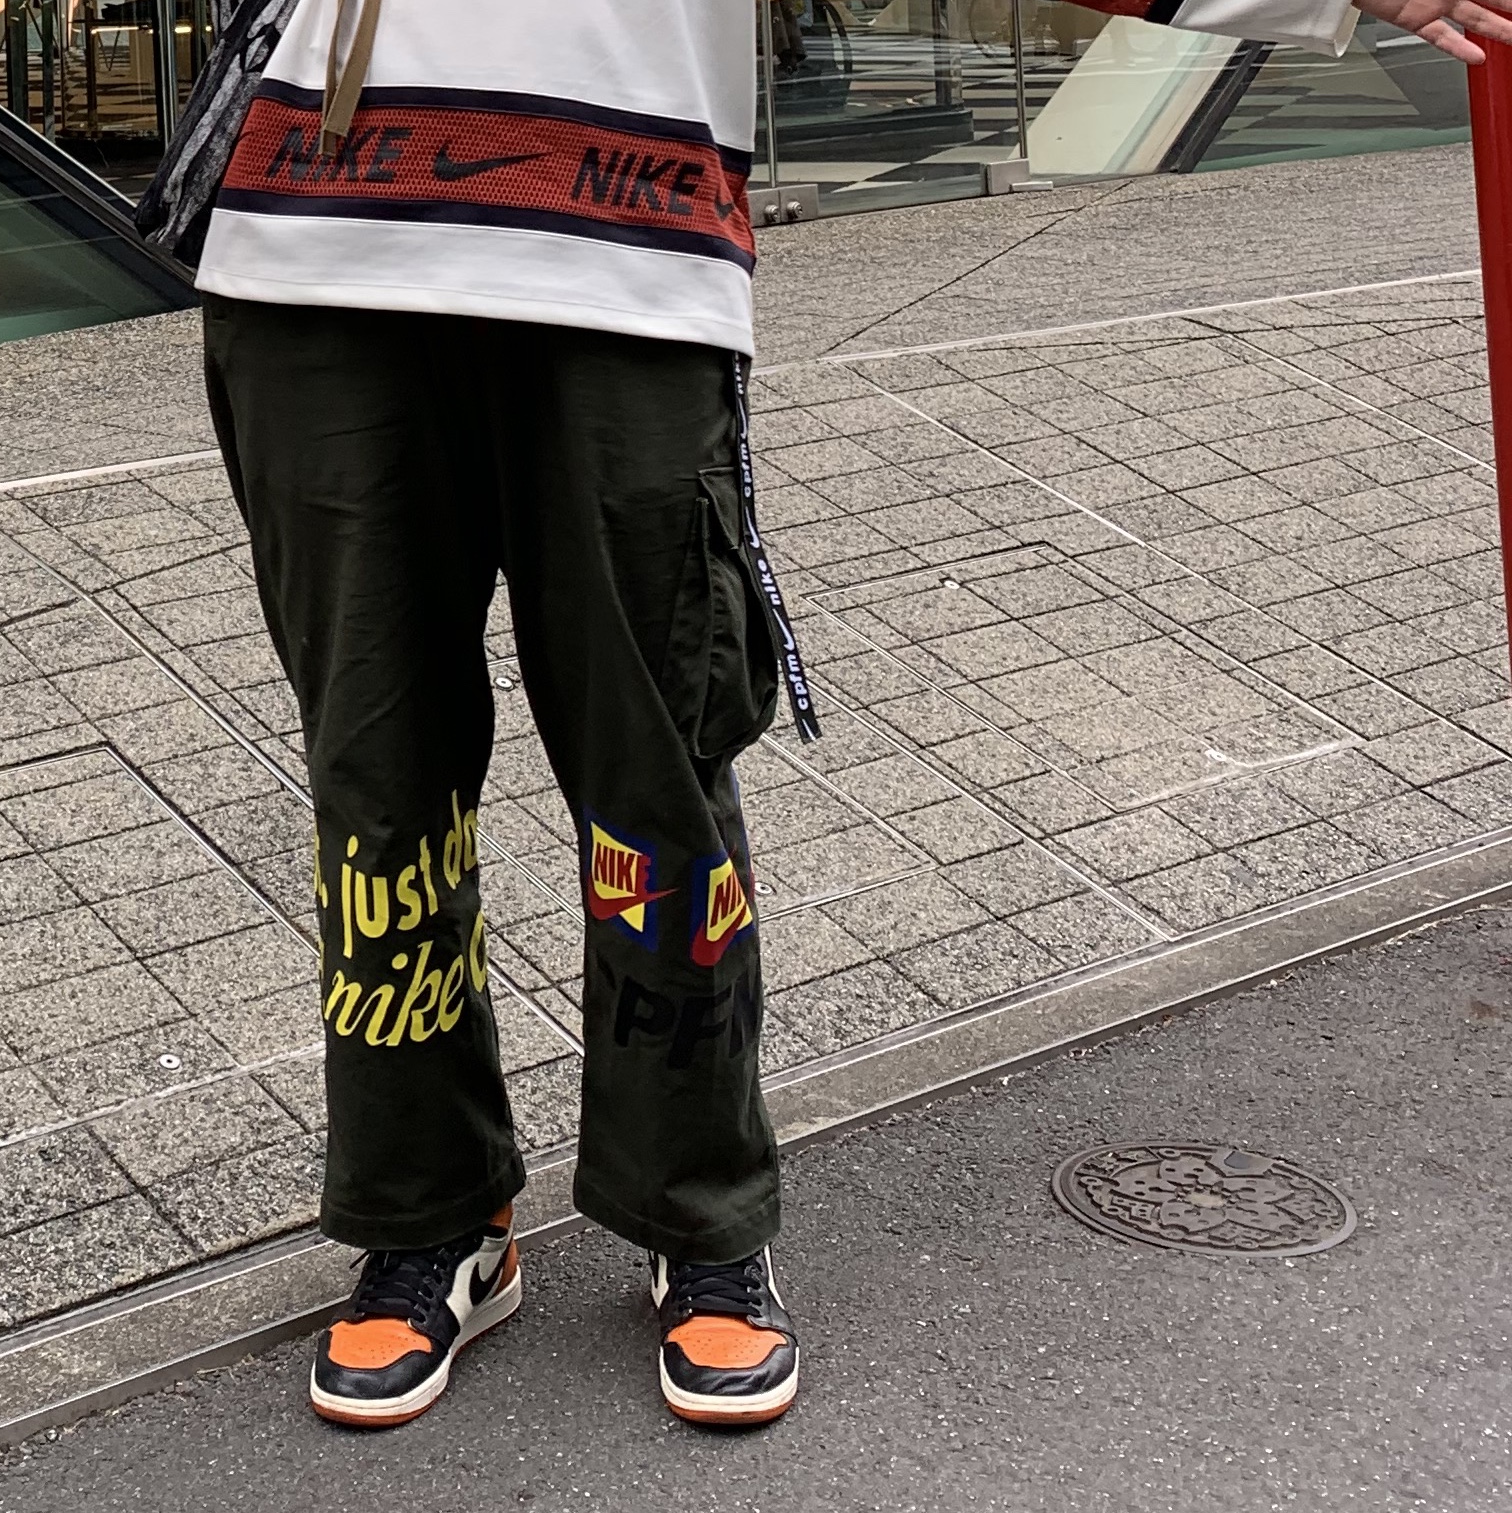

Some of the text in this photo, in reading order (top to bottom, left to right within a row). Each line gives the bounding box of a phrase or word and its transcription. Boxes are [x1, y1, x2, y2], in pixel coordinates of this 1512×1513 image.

[570, 146, 706, 216] NIKE
[786, 653, 809, 711] cpfm
[341, 834, 439, 959] just
